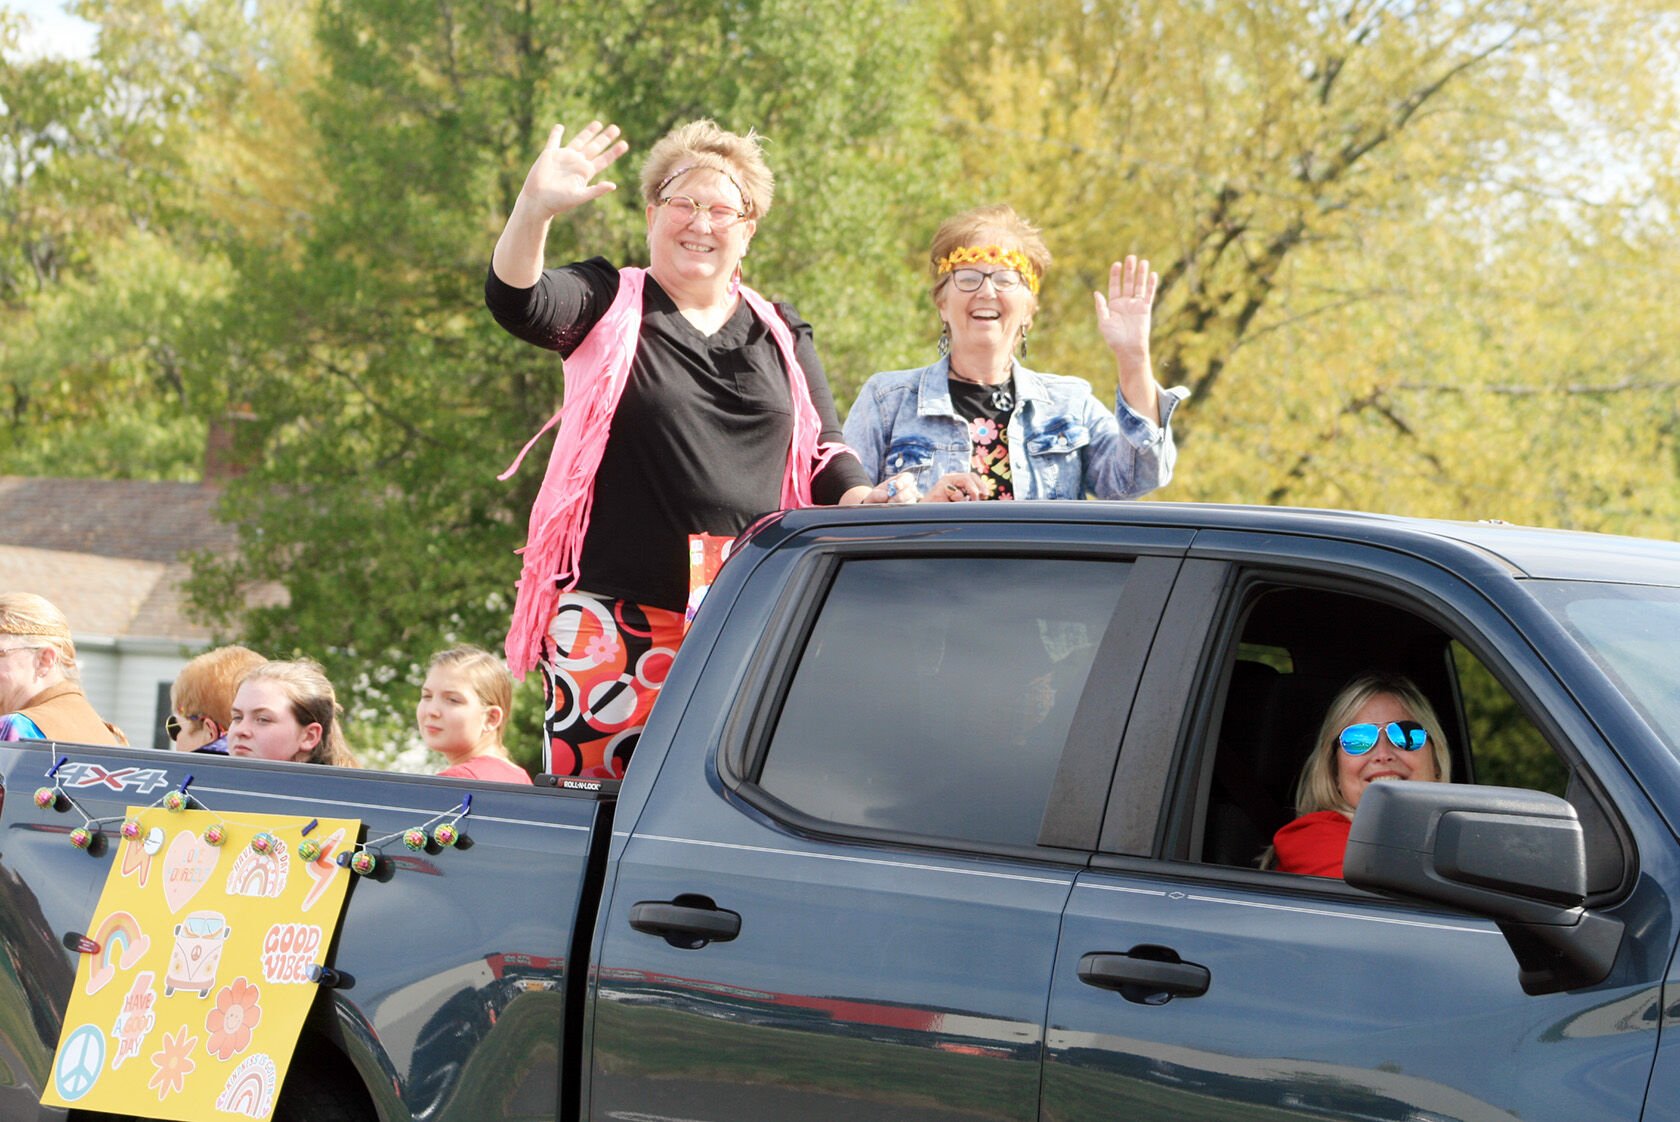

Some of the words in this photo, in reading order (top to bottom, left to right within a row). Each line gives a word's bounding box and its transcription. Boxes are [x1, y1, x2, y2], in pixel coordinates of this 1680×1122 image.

[45, 762, 168, 794] 4X4
[264, 925, 321, 954] GOOD
[124, 992, 154, 1014] HAVE
[119, 1037, 143, 1057] DAY
